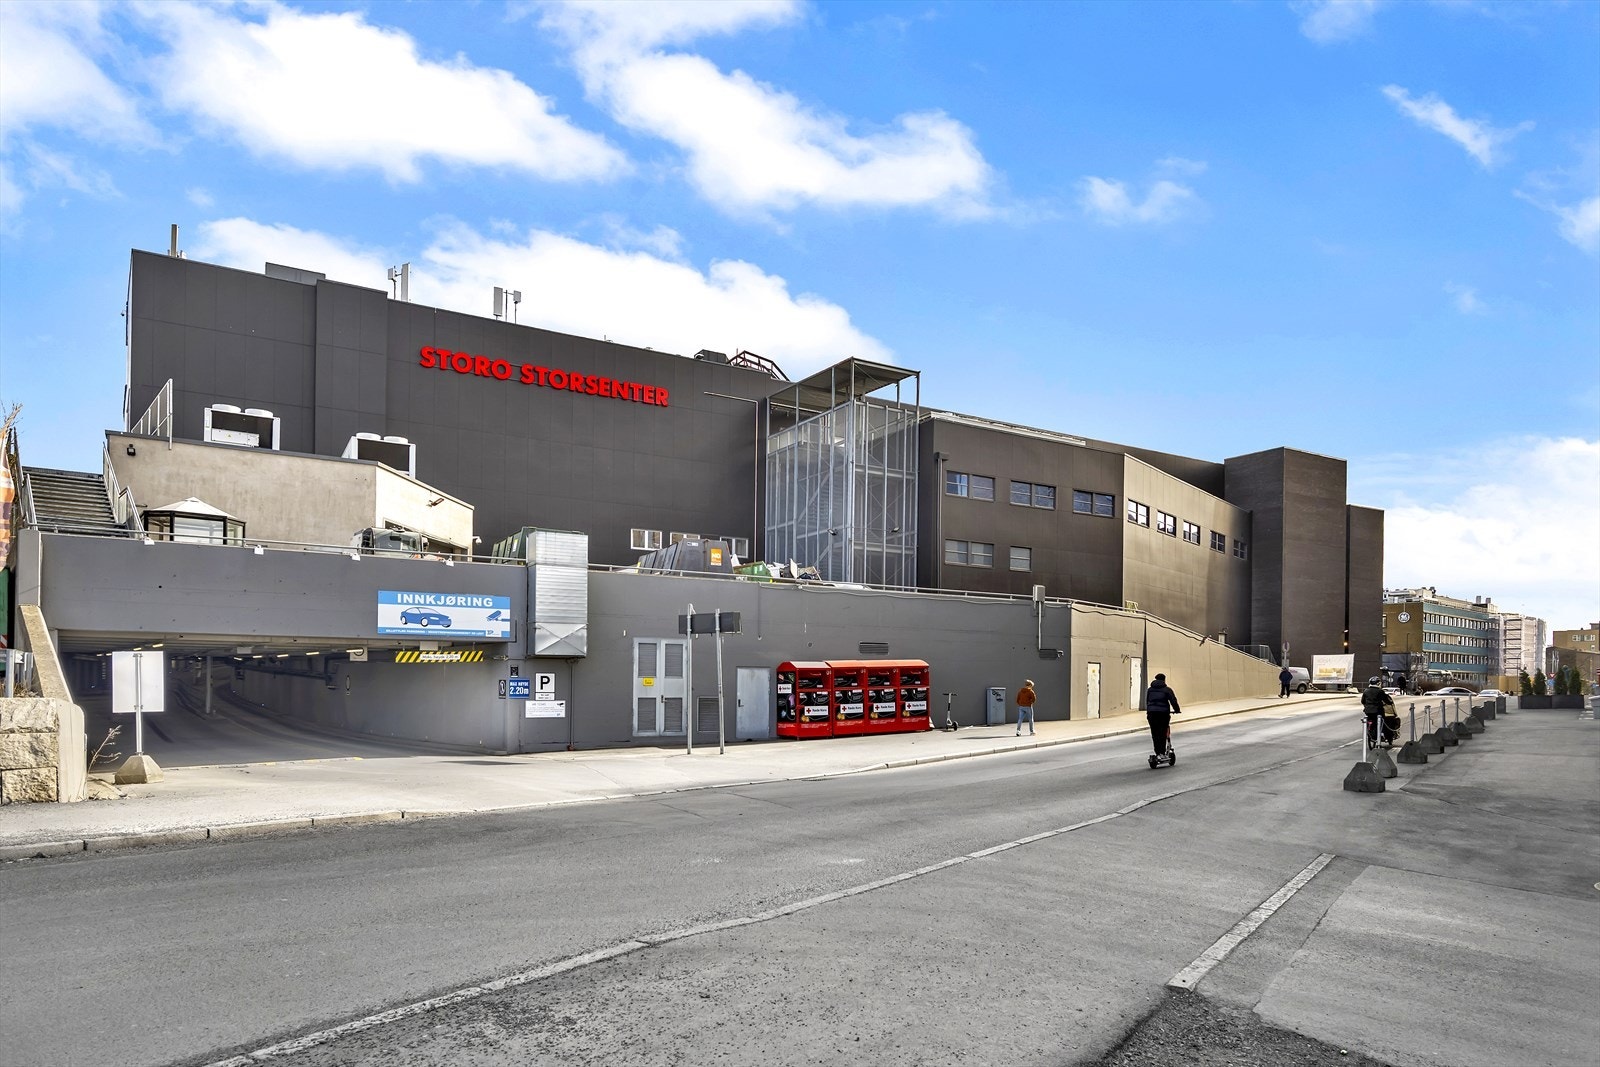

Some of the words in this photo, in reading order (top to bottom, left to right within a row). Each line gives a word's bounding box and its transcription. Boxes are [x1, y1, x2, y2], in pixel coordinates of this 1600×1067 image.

[419, 346, 512, 380] STORO
[520, 363, 669, 406] STORSENTER
[397, 593, 493, 607] INNKJØRING
[540, 675, 550, 690] P
